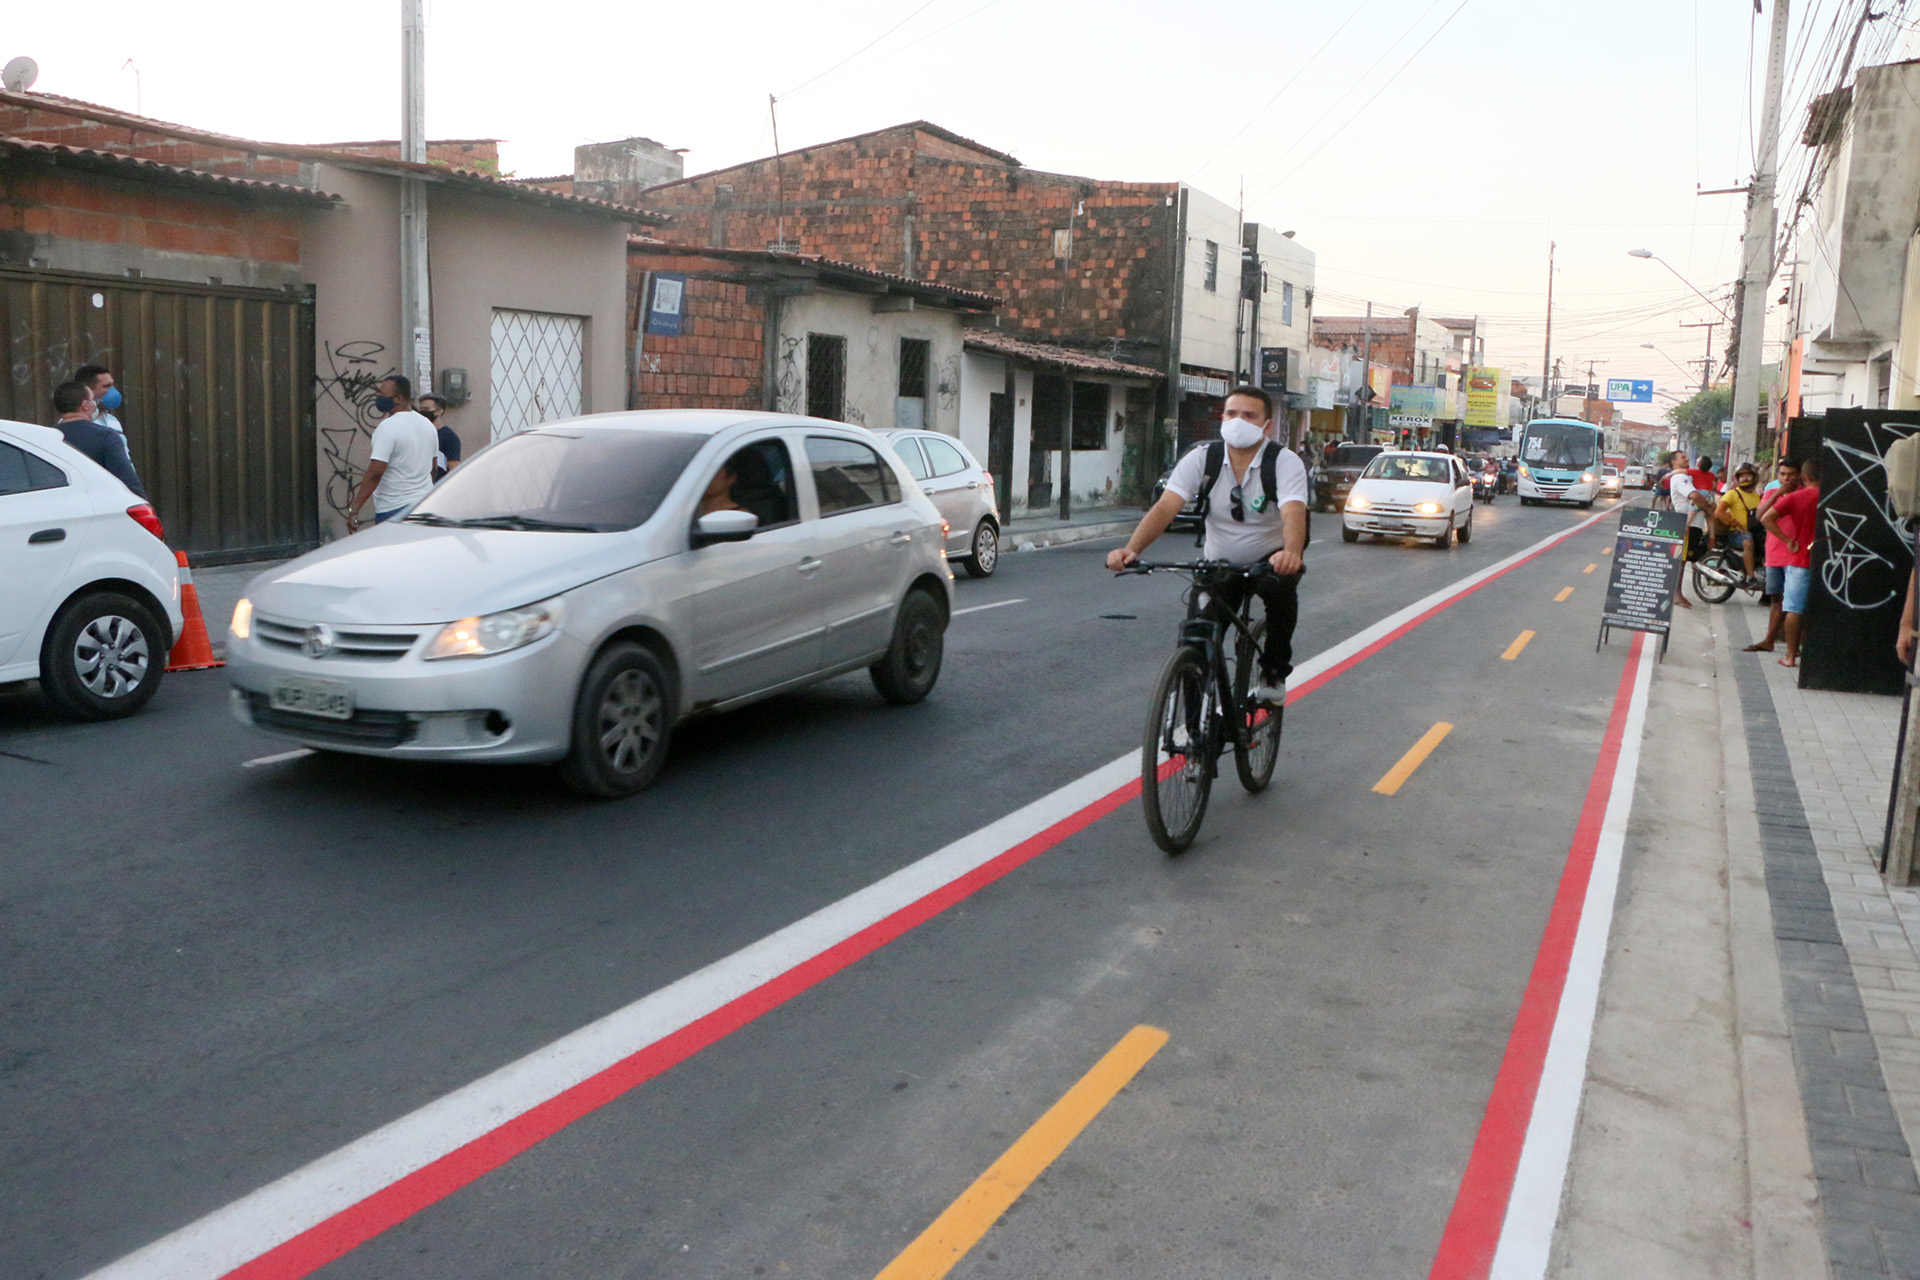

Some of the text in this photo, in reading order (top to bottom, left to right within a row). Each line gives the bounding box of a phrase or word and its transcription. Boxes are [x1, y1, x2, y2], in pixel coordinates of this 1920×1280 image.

[1610, 382, 1630, 391] UPA
[1391, 416, 1430, 424] XEROX
[1528, 437, 1542, 448] 754
[1622, 525, 1680, 538] DIEGO CELL
